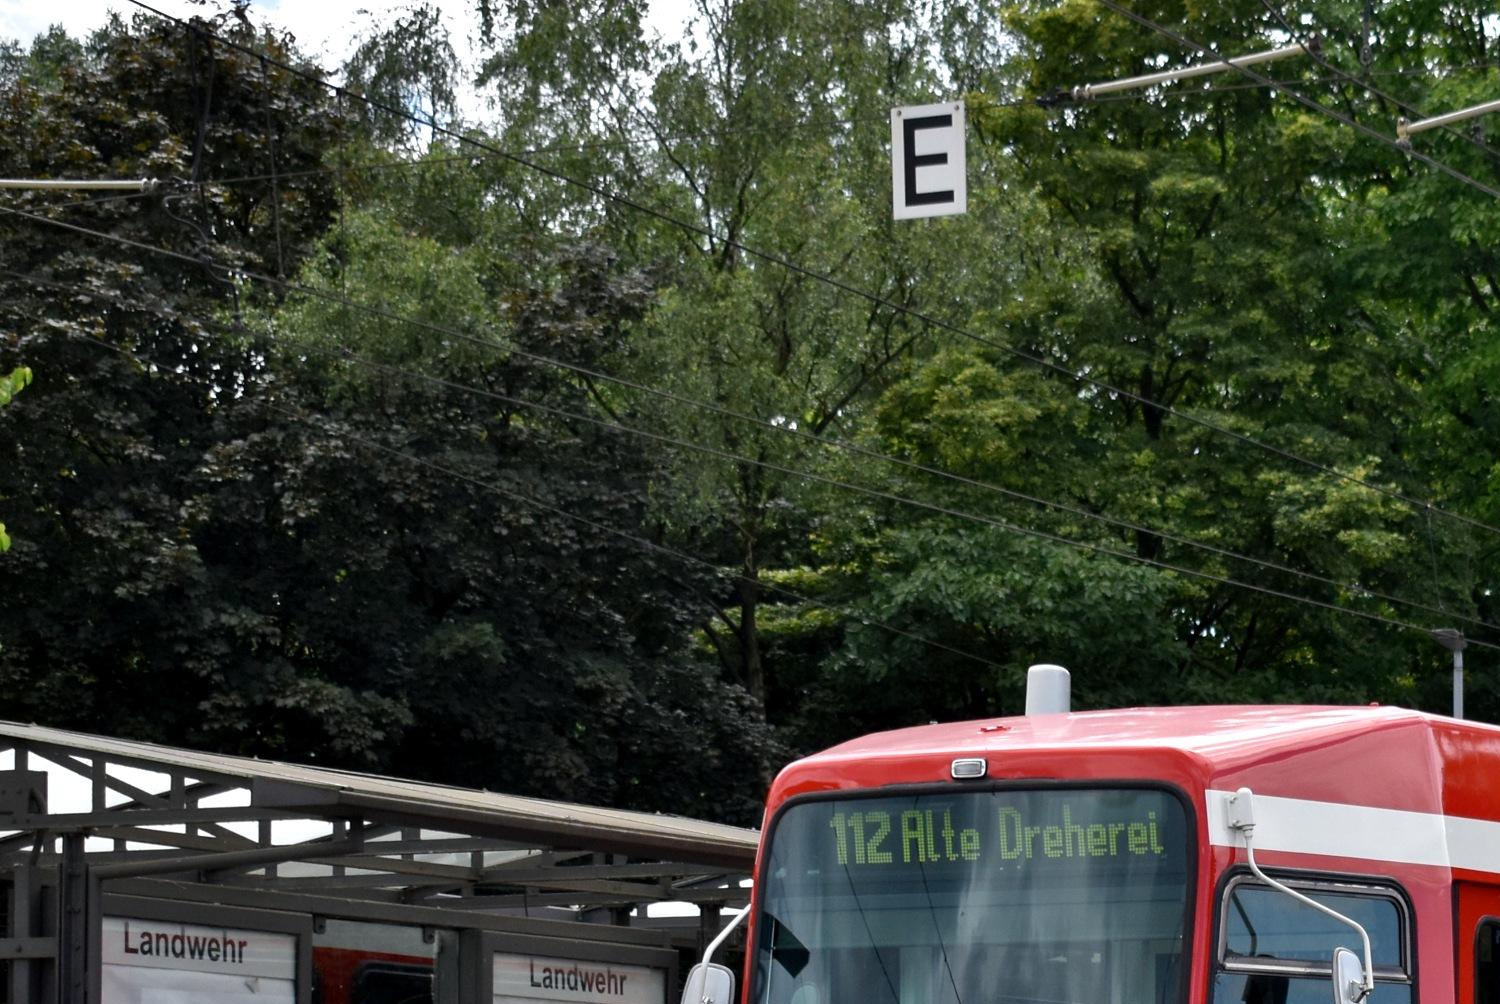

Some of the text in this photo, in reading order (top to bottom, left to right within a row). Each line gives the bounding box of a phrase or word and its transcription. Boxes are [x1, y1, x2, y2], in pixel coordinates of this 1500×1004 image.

[903, 114, 955, 207] E
[829, 804, 1164, 864] 112 Alte Dreherei
[124, 921, 248, 964] Landwehr
[529, 959, 627, 996] Landwehr
